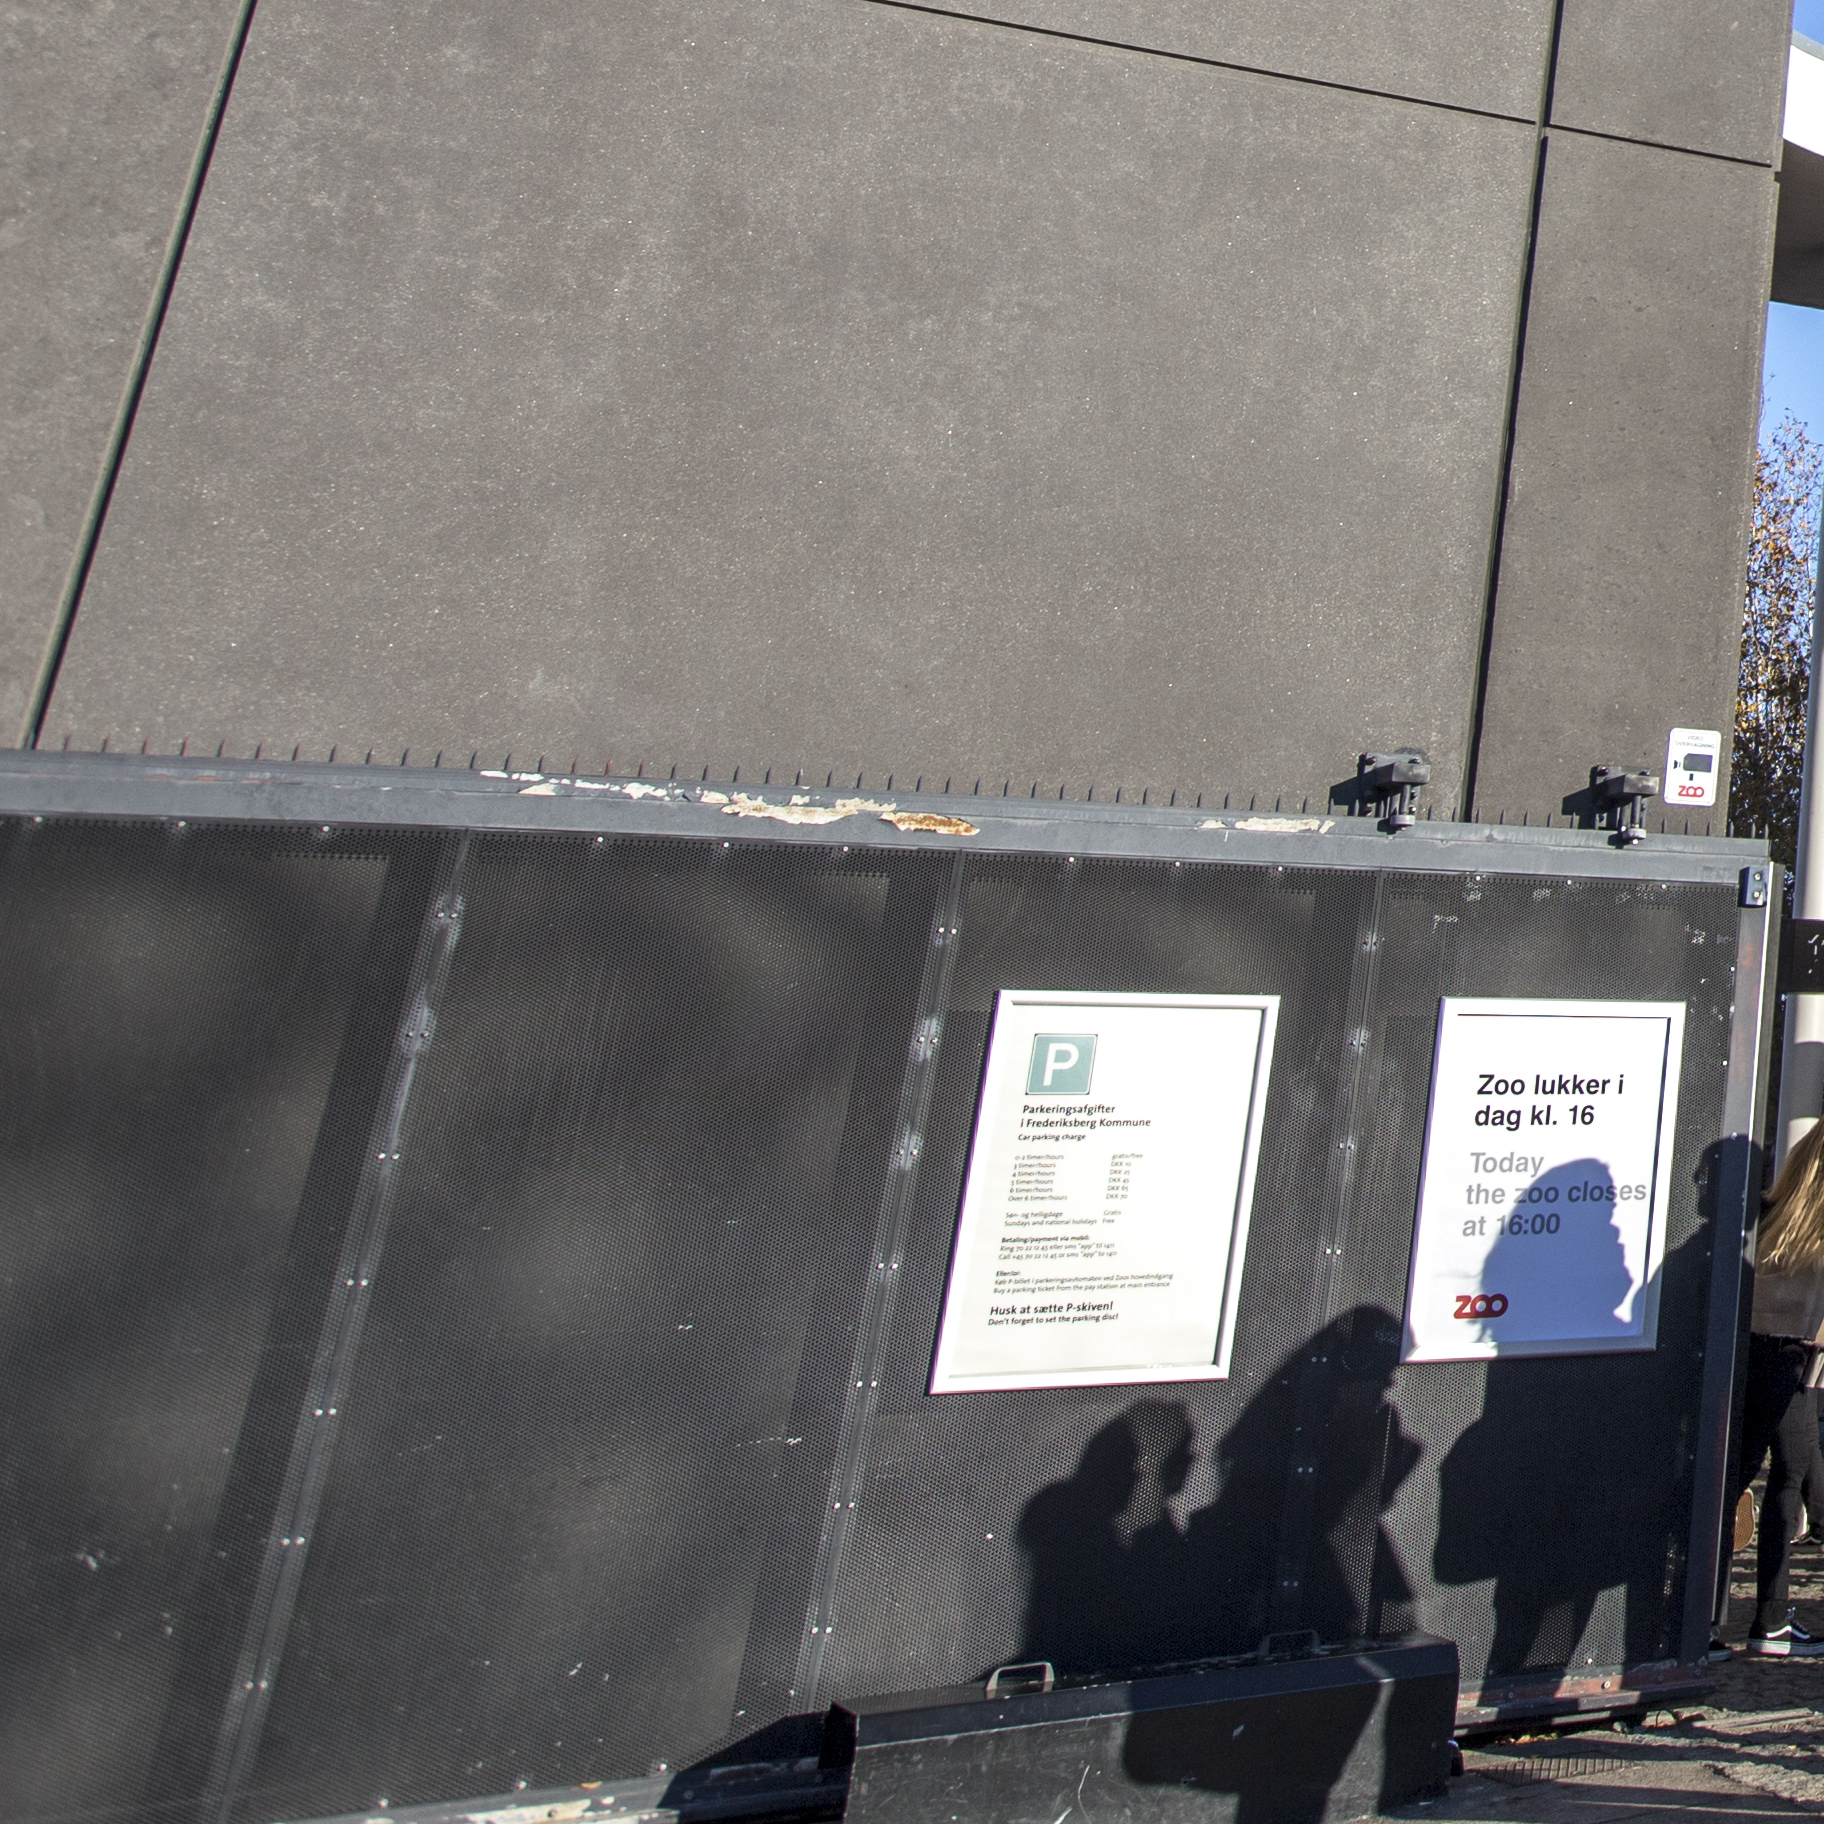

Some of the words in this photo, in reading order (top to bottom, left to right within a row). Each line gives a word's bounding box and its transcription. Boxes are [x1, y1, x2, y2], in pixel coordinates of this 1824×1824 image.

[1042, 1042, 1080, 1086] P
[1477, 1074, 1525, 1095] Zoo
[1534, 1074, 1610, 1095] lukker
[1618, 1074, 1624, 1094] i
[1022, 1104, 1116, 1117] Parkeringsafgifter
[1474, 1104, 1522, 1131] dag
[1530, 1104, 1558, 1126] kl.
[1569, 1105, 1595, 1126] 16
[1026, 1117, 1097, 1129] Frederiksberg
[1099, 1118, 1152, 1127] Kommune
[1018, 1133, 1030, 1141] Car
[1031, 1133, 1060, 1142] parking
[1061, 1133, 1086, 1142] charge
[1470, 1151, 1544, 1178] Today
[1466, 1183, 1506, 1205] the
[1514, 1186, 1560, 1204] zoo
[1567, 1181, 1647, 1203] closes
[1462, 1215, 1486, 1237] at
[1496, 1213, 1561, 1236] 16:00
[990, 1305, 1017, 1315] Husk
[1020, 1305, 1031, 1314] at
[1034, 1303, 1064, 1313] sætte
[1066, 1300, 1114, 1312] P-skiven!
[1011, 1317, 1034, 1326] forget
[1072, 1314, 1101, 1324] parking
